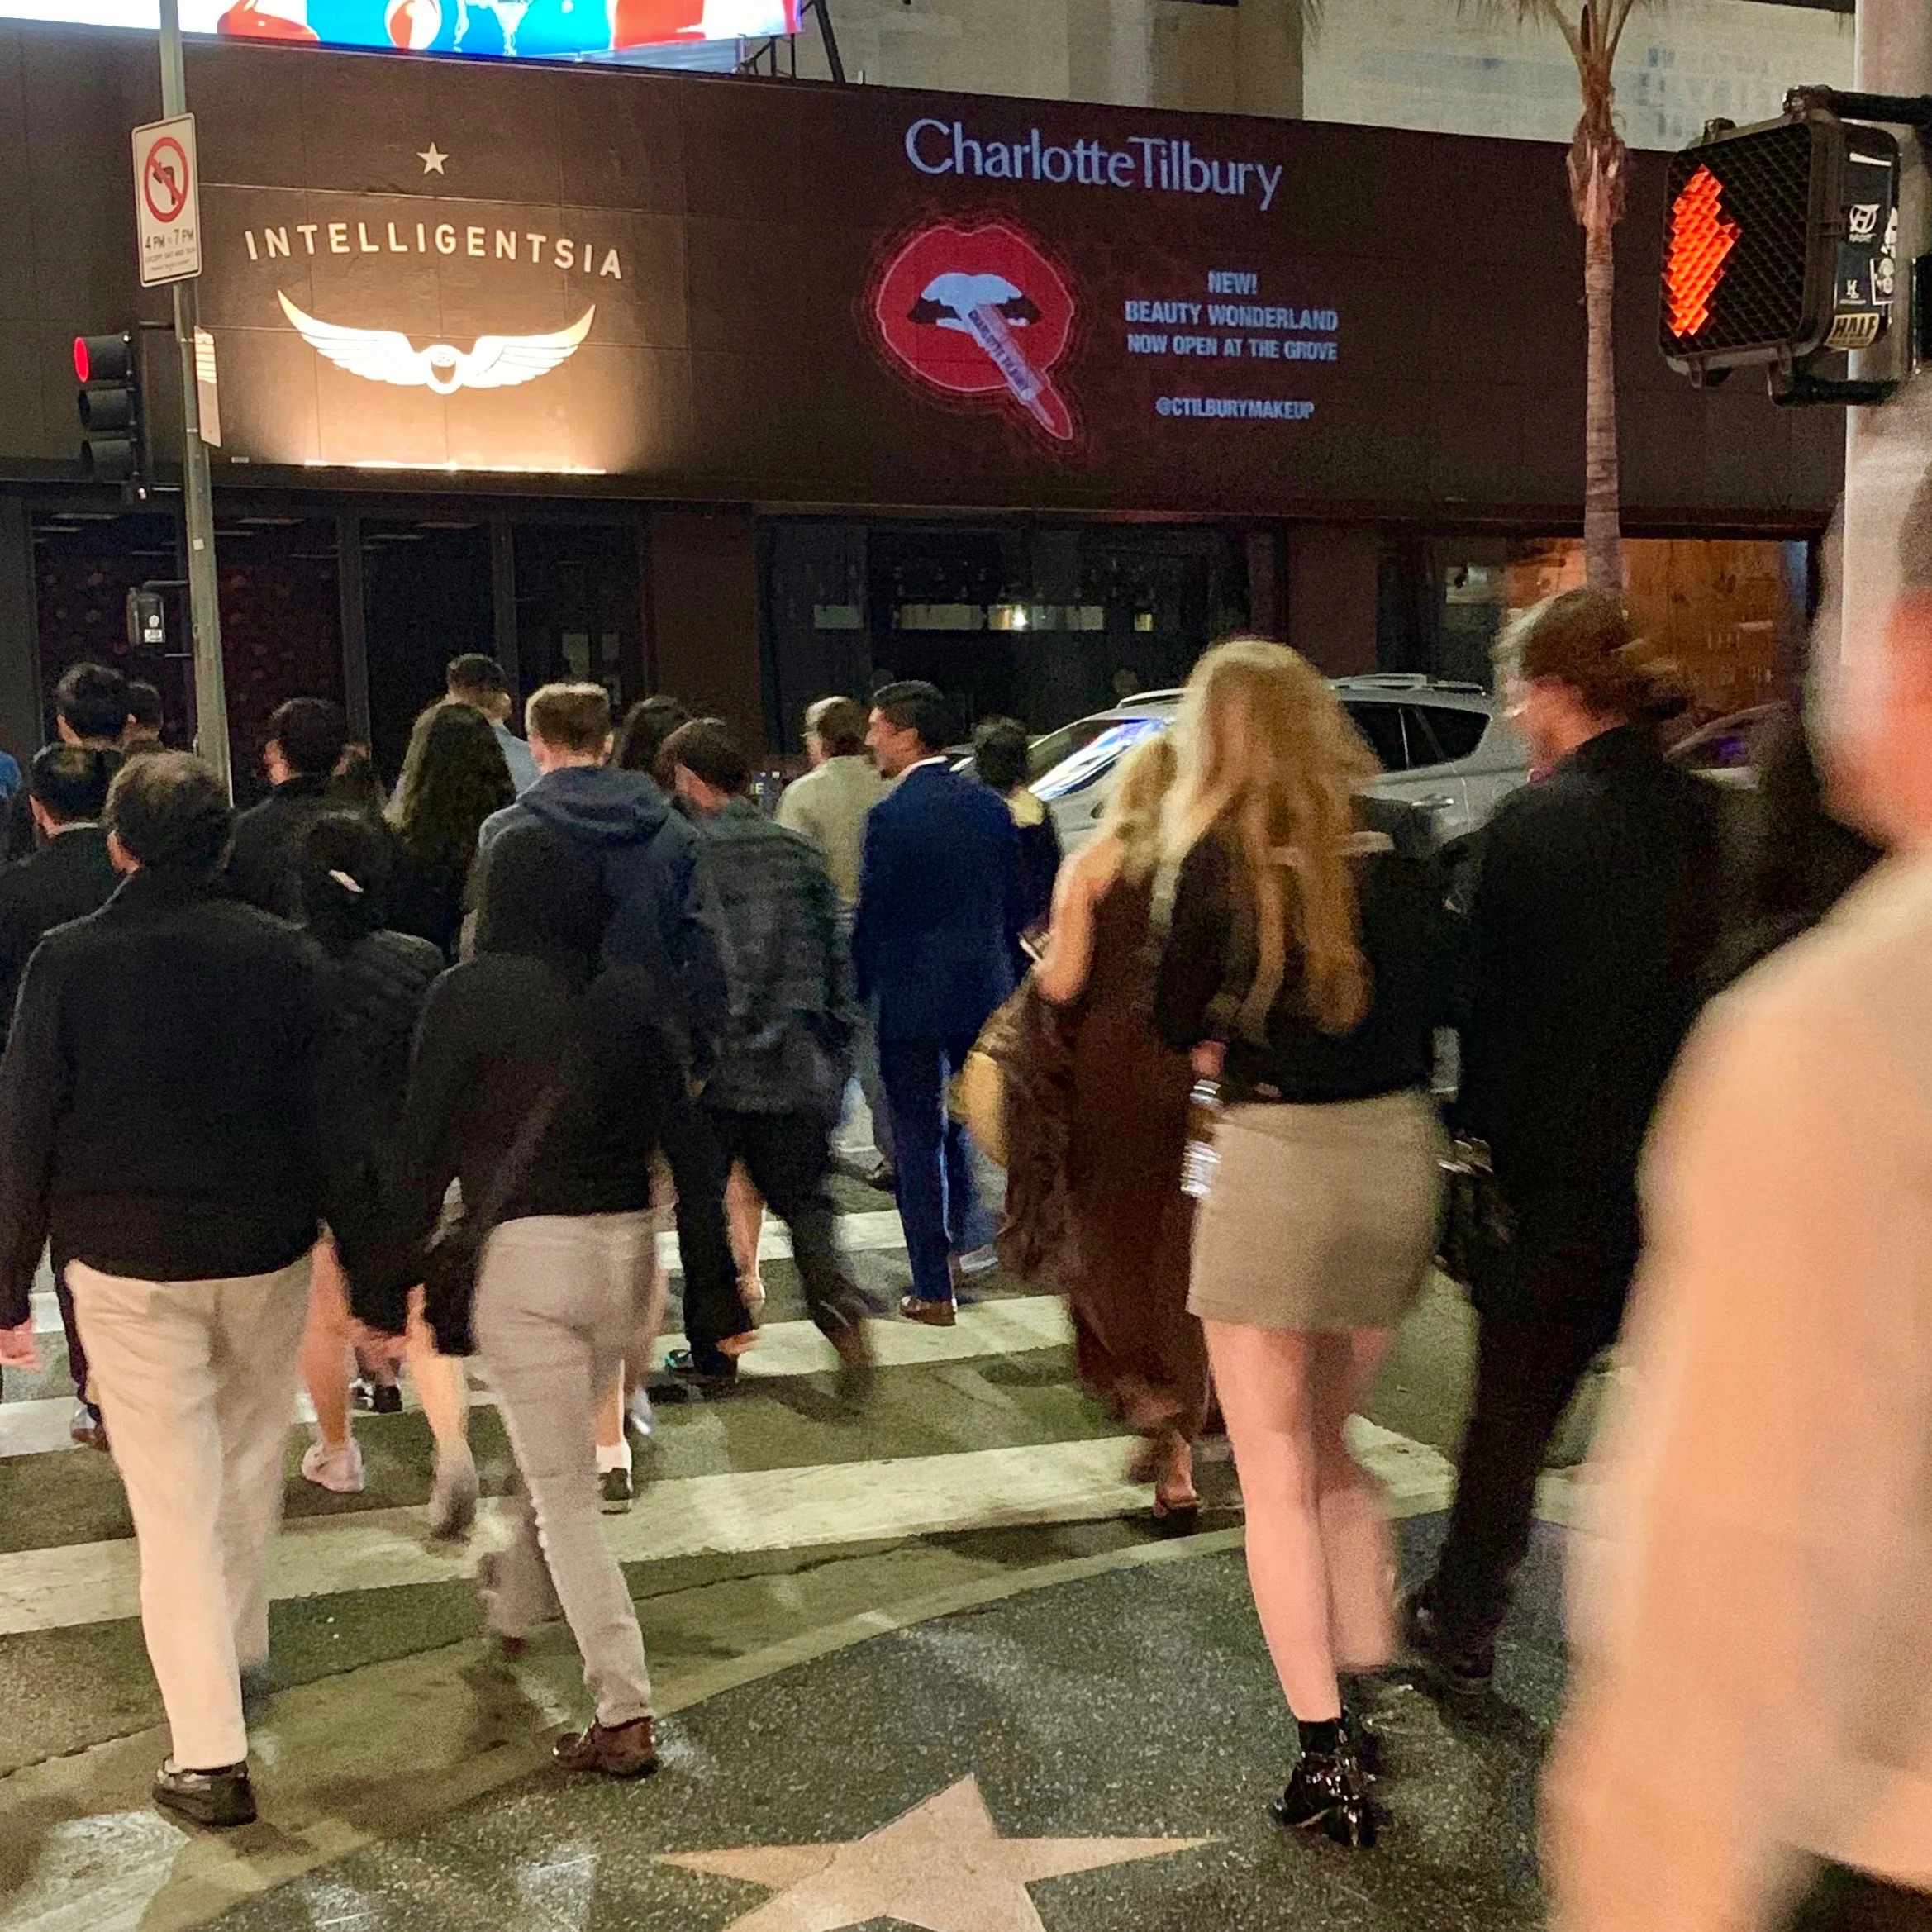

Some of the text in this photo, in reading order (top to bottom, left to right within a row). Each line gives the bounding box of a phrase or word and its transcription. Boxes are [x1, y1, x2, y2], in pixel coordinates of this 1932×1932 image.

[145, 236, 151, 250] 4
[153, 235, 165, 250] PM
[173, 228, 180, 245] 7
[182, 228, 194, 243] PM
[245, 221, 623, 279] INTELLIGENTSIA
[1207, 270, 1258, 295] NEW!
[1125, 300, 1339, 331] BEAUTY WONDERLAND
[1832, 316, 1877, 338] HALF
[1127, 333, 1338, 361] NOW OPEN AT THE GROVE
[1155, 397, 1315, 419] @CTILBURYMAKEUP
